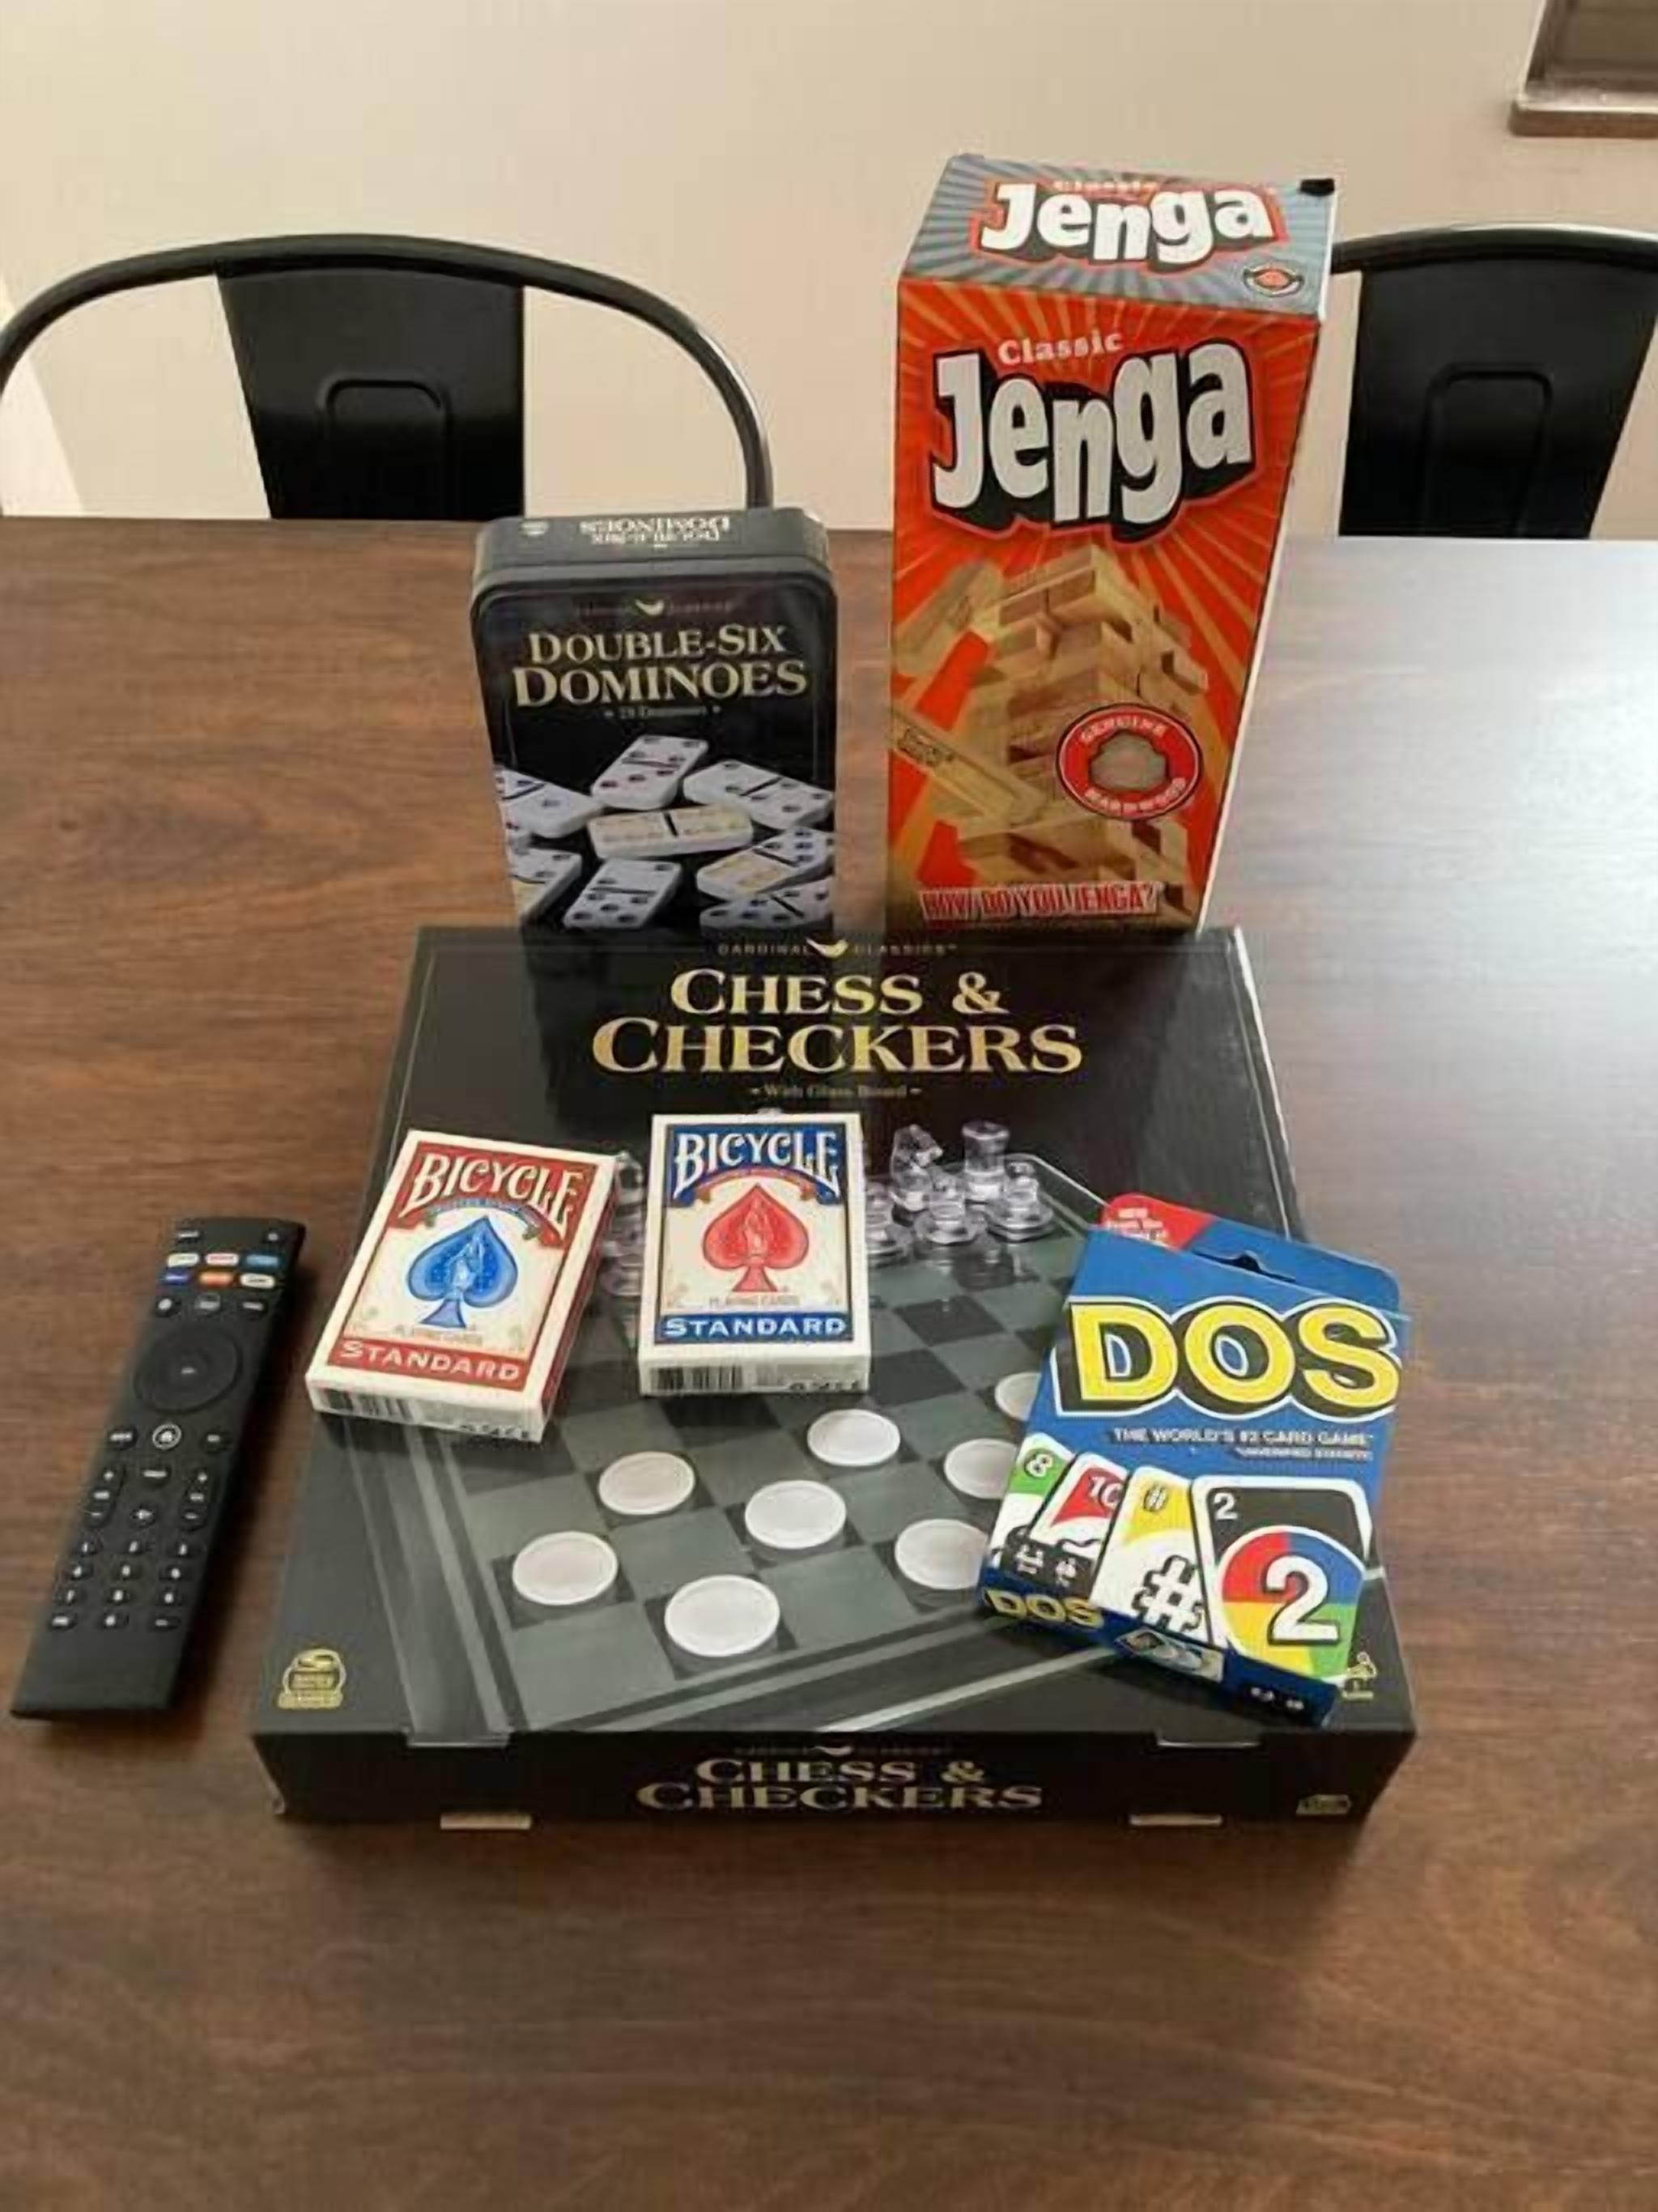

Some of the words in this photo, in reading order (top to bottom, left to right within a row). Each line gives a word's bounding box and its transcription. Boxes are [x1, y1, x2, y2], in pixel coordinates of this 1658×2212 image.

[979, 183, 1275, 263] Jenga
[997, 330, 1124, 365] Classic
[932, 342, 1253, 524] Jenga
[529, 623, 787, 665] DOUBLE-SIX
[512, 660, 807, 707] DOMINOES
[670, 968, 922, 1015] CHESS
[951, 972, 1010, 1015] &
[592, 1016, 1082, 1073] CHECKERS
[673, 1132, 840, 1199] BICYCLE
[398, 1151, 584, 1239] BICYCLE
[663, 1317, 848, 1337] STANDARD
[341, 1341, 521, 1381] STANDARD
[1071, 1304, 1399, 1408] DOS
[1026, 1453, 1053, 1478] 8
[1214, 1492, 1238, 1521] 2
[986, 1589, 1104, 1628] DOS
[1265, 1555, 1339, 1642] 2
[695, 1759, 916, 1782] CHESS
[941, 1760, 984, 1783] &
[636, 1783, 1043, 1809] CHECKERS
